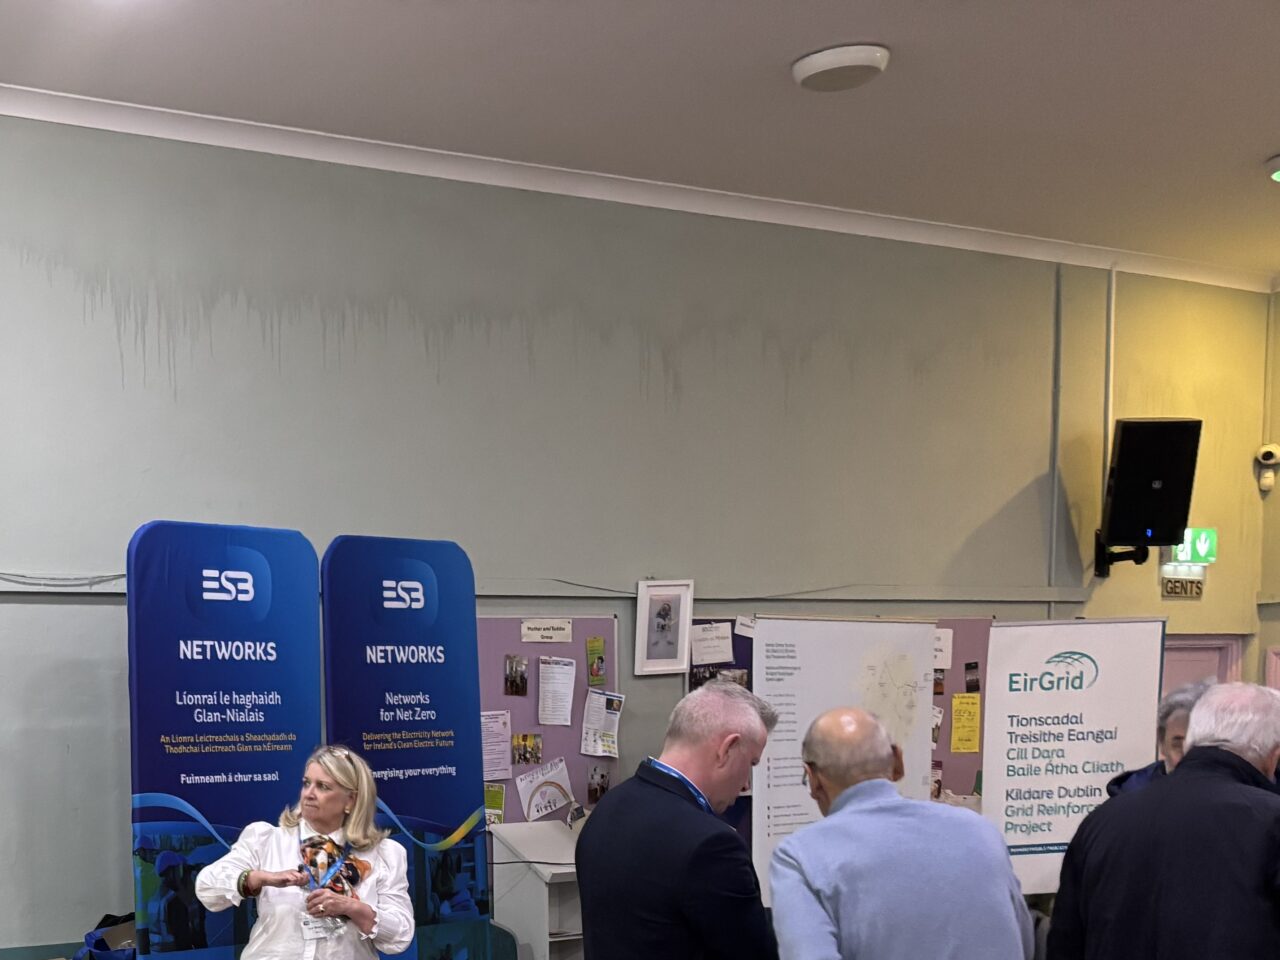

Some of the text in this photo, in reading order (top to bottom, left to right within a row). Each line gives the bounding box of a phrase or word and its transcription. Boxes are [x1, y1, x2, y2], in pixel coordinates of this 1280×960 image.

[202, 569, 255, 602] ESB
[1165, 580, 1203, 596] GENTS
[383, 580, 425, 609] ESB
[179, 640, 277, 662] NETWORKS
[366, 645, 445, 664] NETWORKS
[1008, 670, 1084, 693] EirGrid
[176, 691, 282, 709] Líonraí le haghaidh
[385, 691, 430, 706] Networks
[194, 708, 265, 723] Glan-Nialais
[379, 707, 437, 722] for Net Zero
[1008, 712, 1084, 727] Tionscadal
[160, 735, 170, 743] An
[362, 729, 455, 741] Delivering the Electricity Network
[1007, 730, 1065, 744] Treisithe
[363, 742, 372, 751] for
[397, 740, 413, 749] Clean
[414, 739, 434, 748] Electric
[435, 739, 455, 747] Future
[1006, 747, 1066, 761] Cill Dara
[371, 765, 456, 780] nergising your everything
[1006, 760, 1125, 777] Baile Átha Cliath
[180, 772, 227, 784] Fuinneamh
[234, 772, 252, 782] chur
[263, 771, 279, 781] saol
[1006, 785, 1102, 801] Kildare Dublin
[1005, 803, 1096, 818] Grid Reinforc
[1005, 821, 1053, 836] Project
